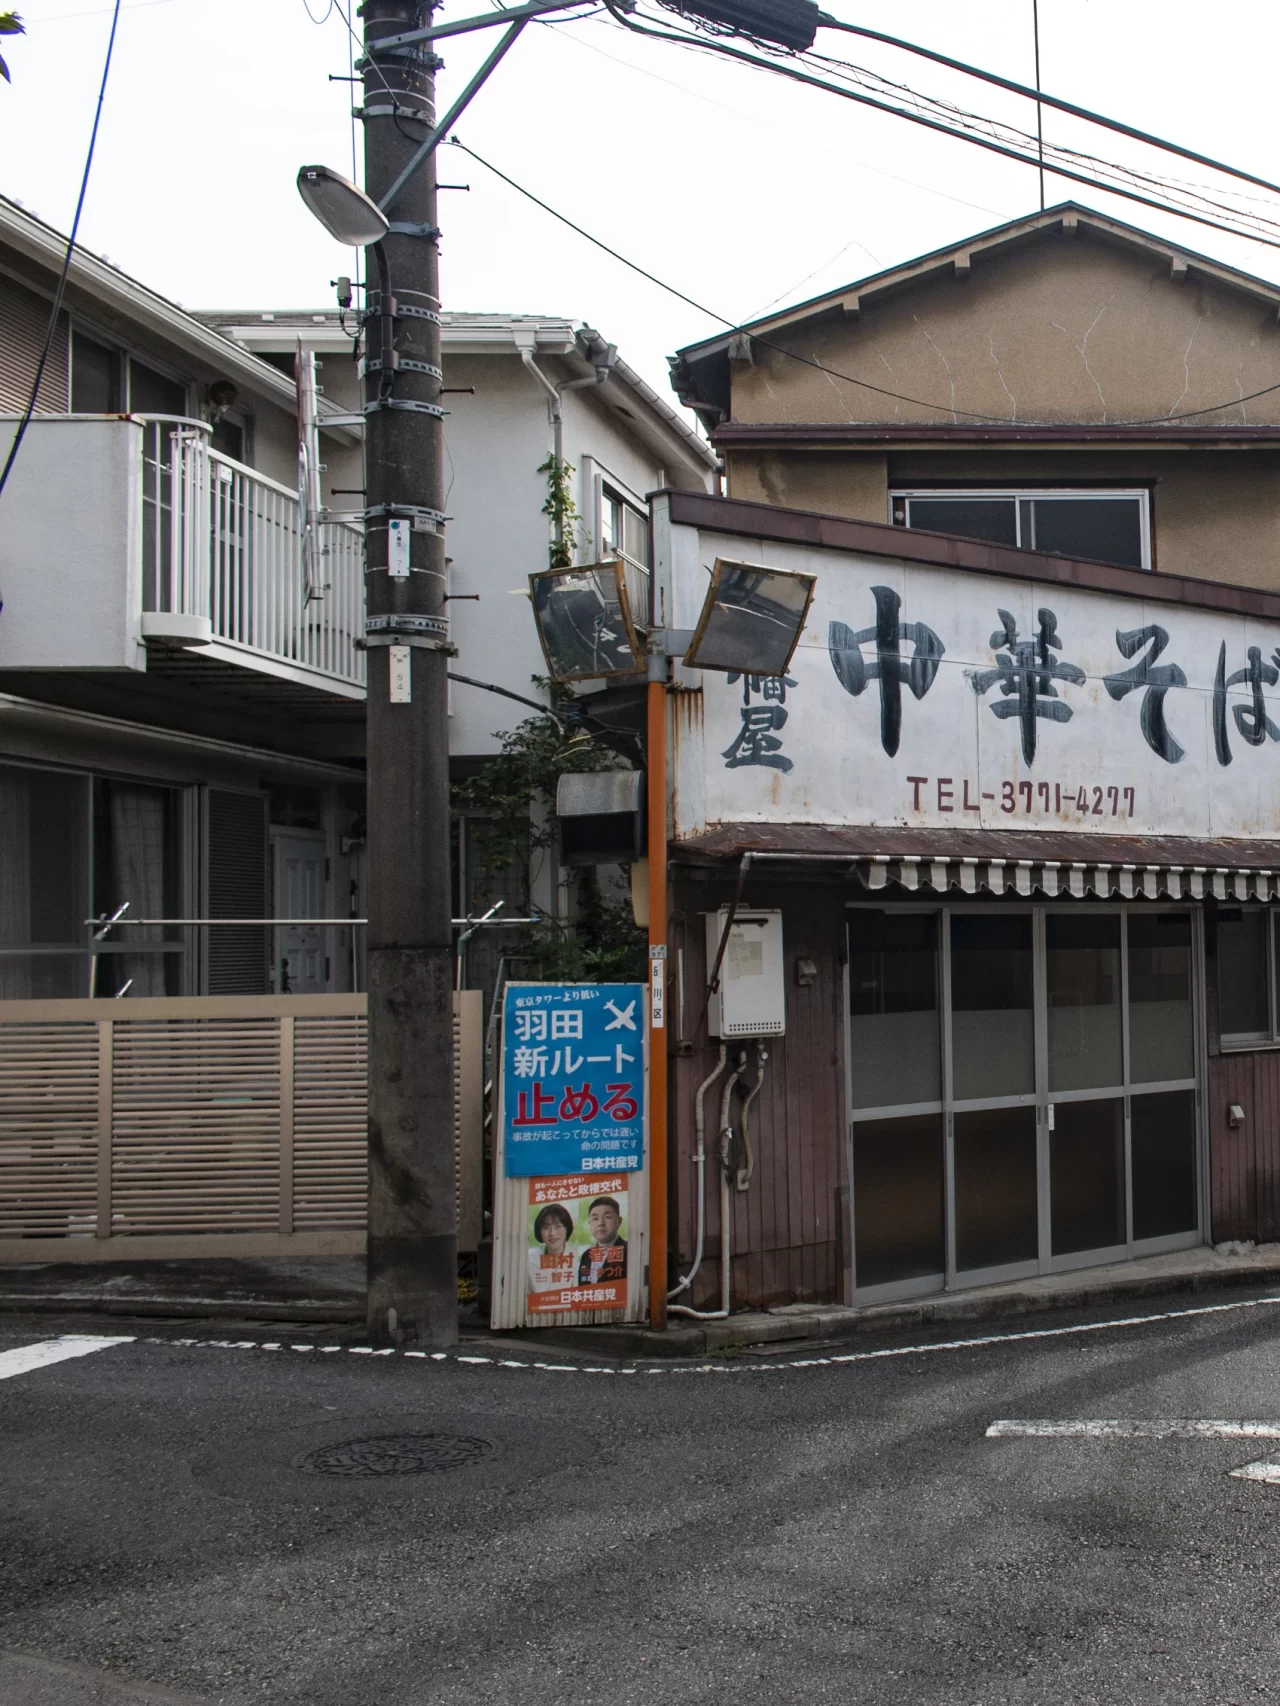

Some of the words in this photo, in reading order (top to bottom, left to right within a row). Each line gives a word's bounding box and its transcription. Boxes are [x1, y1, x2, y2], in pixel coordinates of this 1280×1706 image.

[515, 990, 600, 1008] 東京タワーより低い
[514, 1009, 583, 1041] 羽田
[514, 1044, 635, 1078] 新ルート
[512, 1081, 638, 1126] 止める
[512, 1127, 639, 1142] 事故が起こってからでは遅い
[581, 1139, 638, 1151] 命の問題です
[581, 1155, 638, 1171] 日本共産党
[535, 1178, 622, 1202] あなたと政権交代
[560, 1287, 616, 1303] 日本共産党
